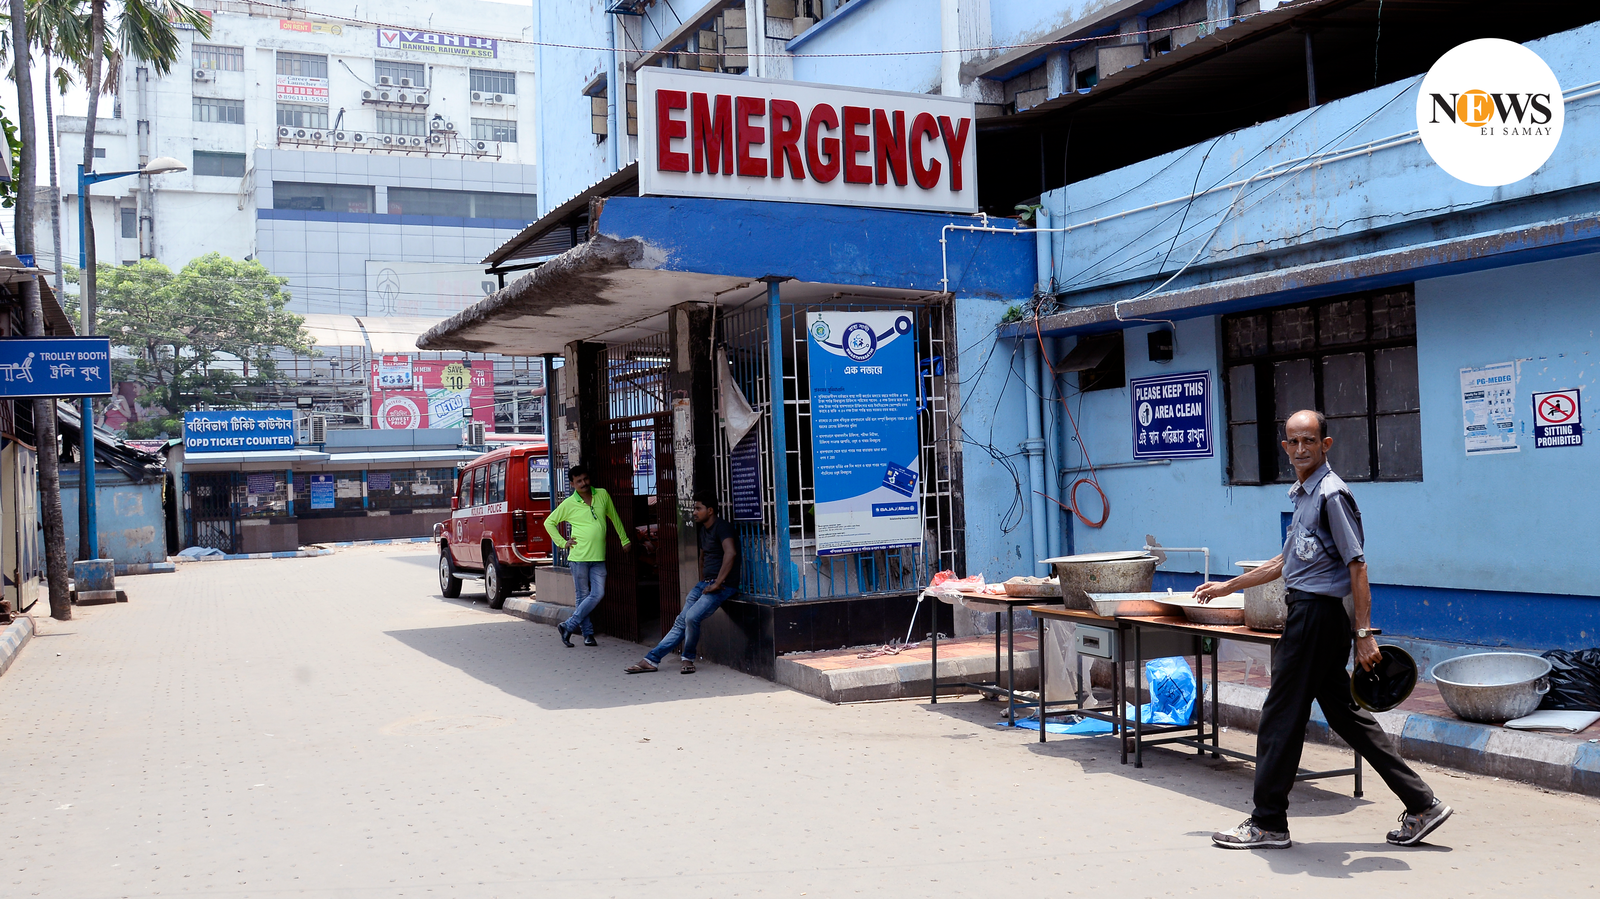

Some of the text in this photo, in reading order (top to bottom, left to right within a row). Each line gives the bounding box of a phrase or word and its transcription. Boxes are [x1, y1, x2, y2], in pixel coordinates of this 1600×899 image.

[438, 46, 470, 54] RAILWAY
[655, 89, 971, 192] EMERGENCY
[40, 352, 107, 360] TROLLEY BOOTH
[50, 363, 76, 380] ট্রলি
[448, 366, 463, 374] SAVE
[844, 366, 858, 375] এক
[1476, 374, 1512, 385] PG-MEDEG
[1136, 382, 1204, 401] PLEASE KEEP THIS
[435, 394, 464, 418] METRO
[1154, 402, 1202, 419] AREA CLEAN
[230, 416, 256, 432] টিকিট
[1544, 425, 1572, 436] SITTING
[186, 434, 294, 448] (OPD TICKET COUNTER)
[1138, 428, 1146, 446] এই
[1148, 430, 1160, 445] স্থান
[1187, 428, 1204, 448] রাখুন
[1537, 434, 1581, 447] PROHIBITED
[488, 504, 502, 514] POLICE
